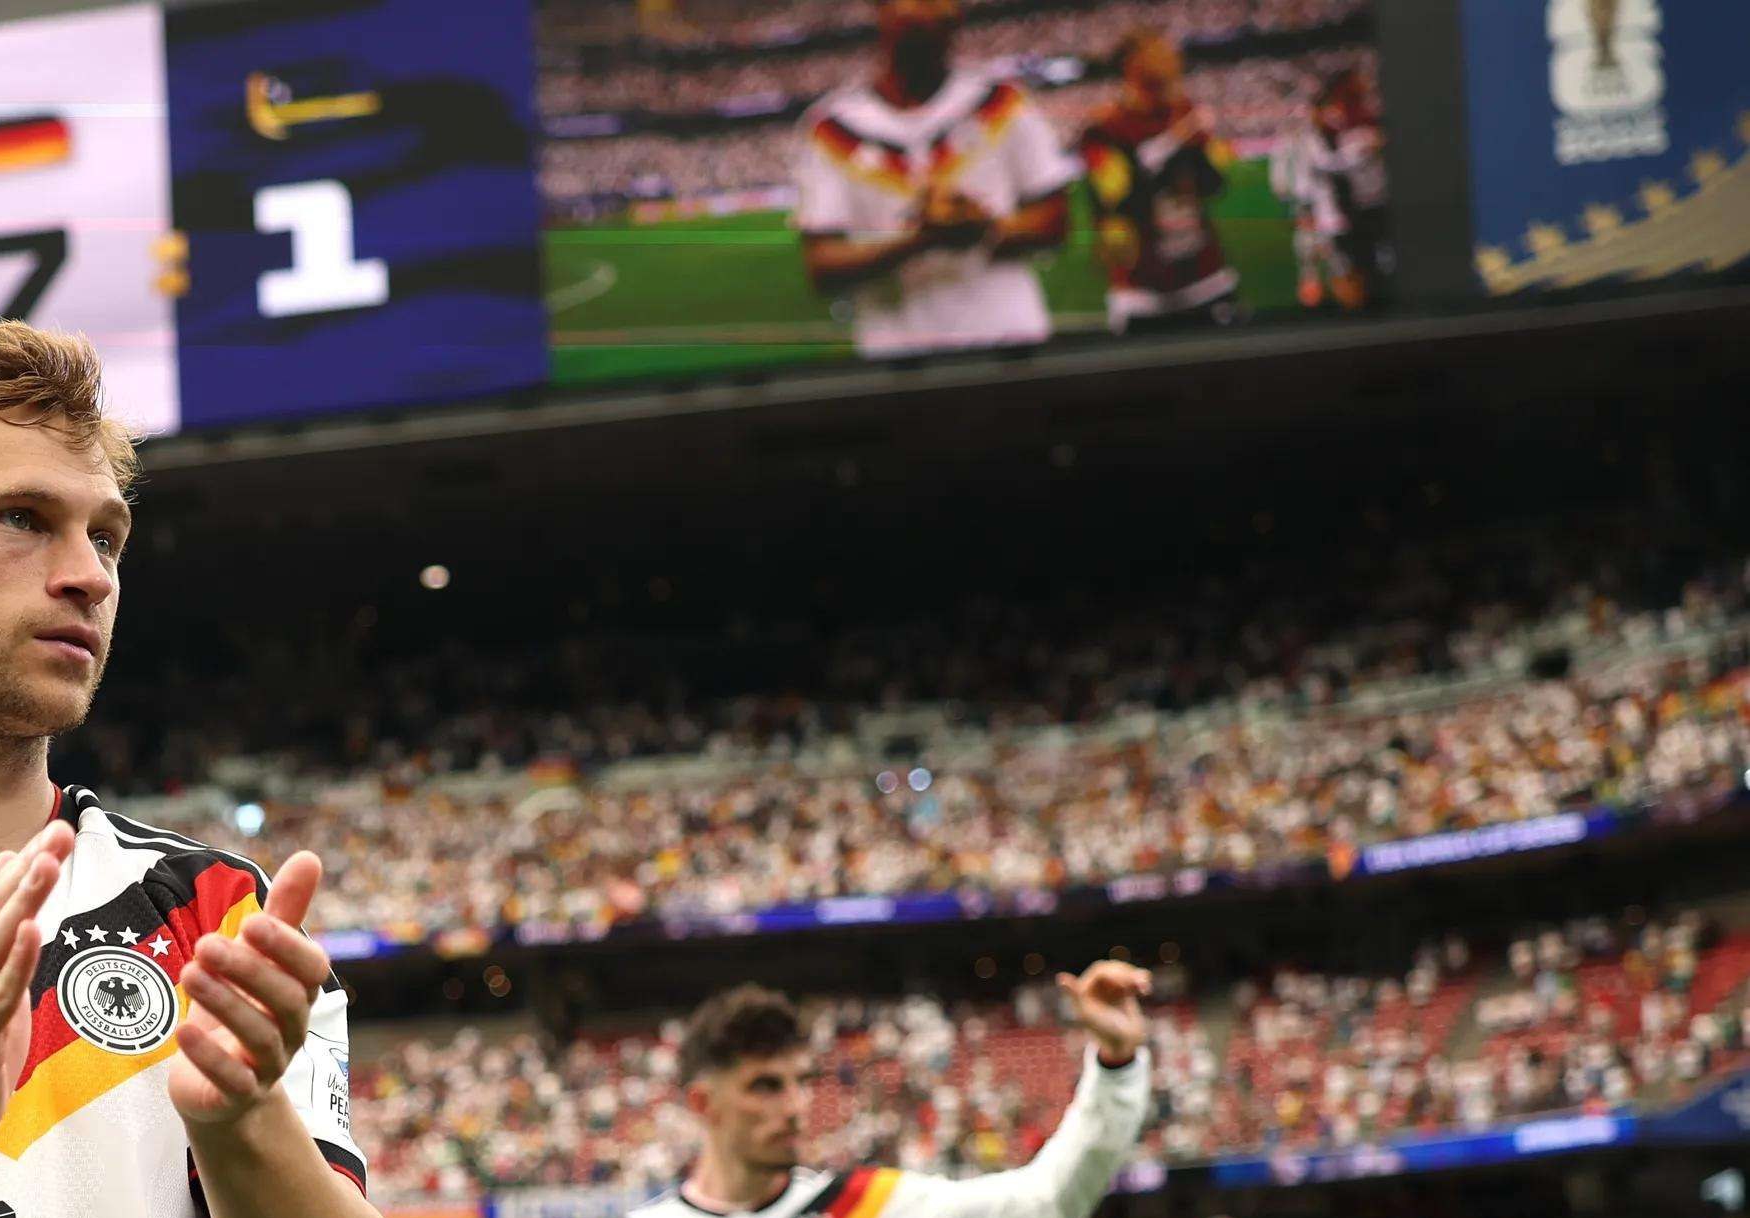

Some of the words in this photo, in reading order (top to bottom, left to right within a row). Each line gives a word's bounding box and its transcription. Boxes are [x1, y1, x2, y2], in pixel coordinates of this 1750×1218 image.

[254, 179, 389, 317] 1
[85, 961, 149, 982] DEUTSCHER
[81, 1004, 158, 1036] FUSSBALL-BUND
